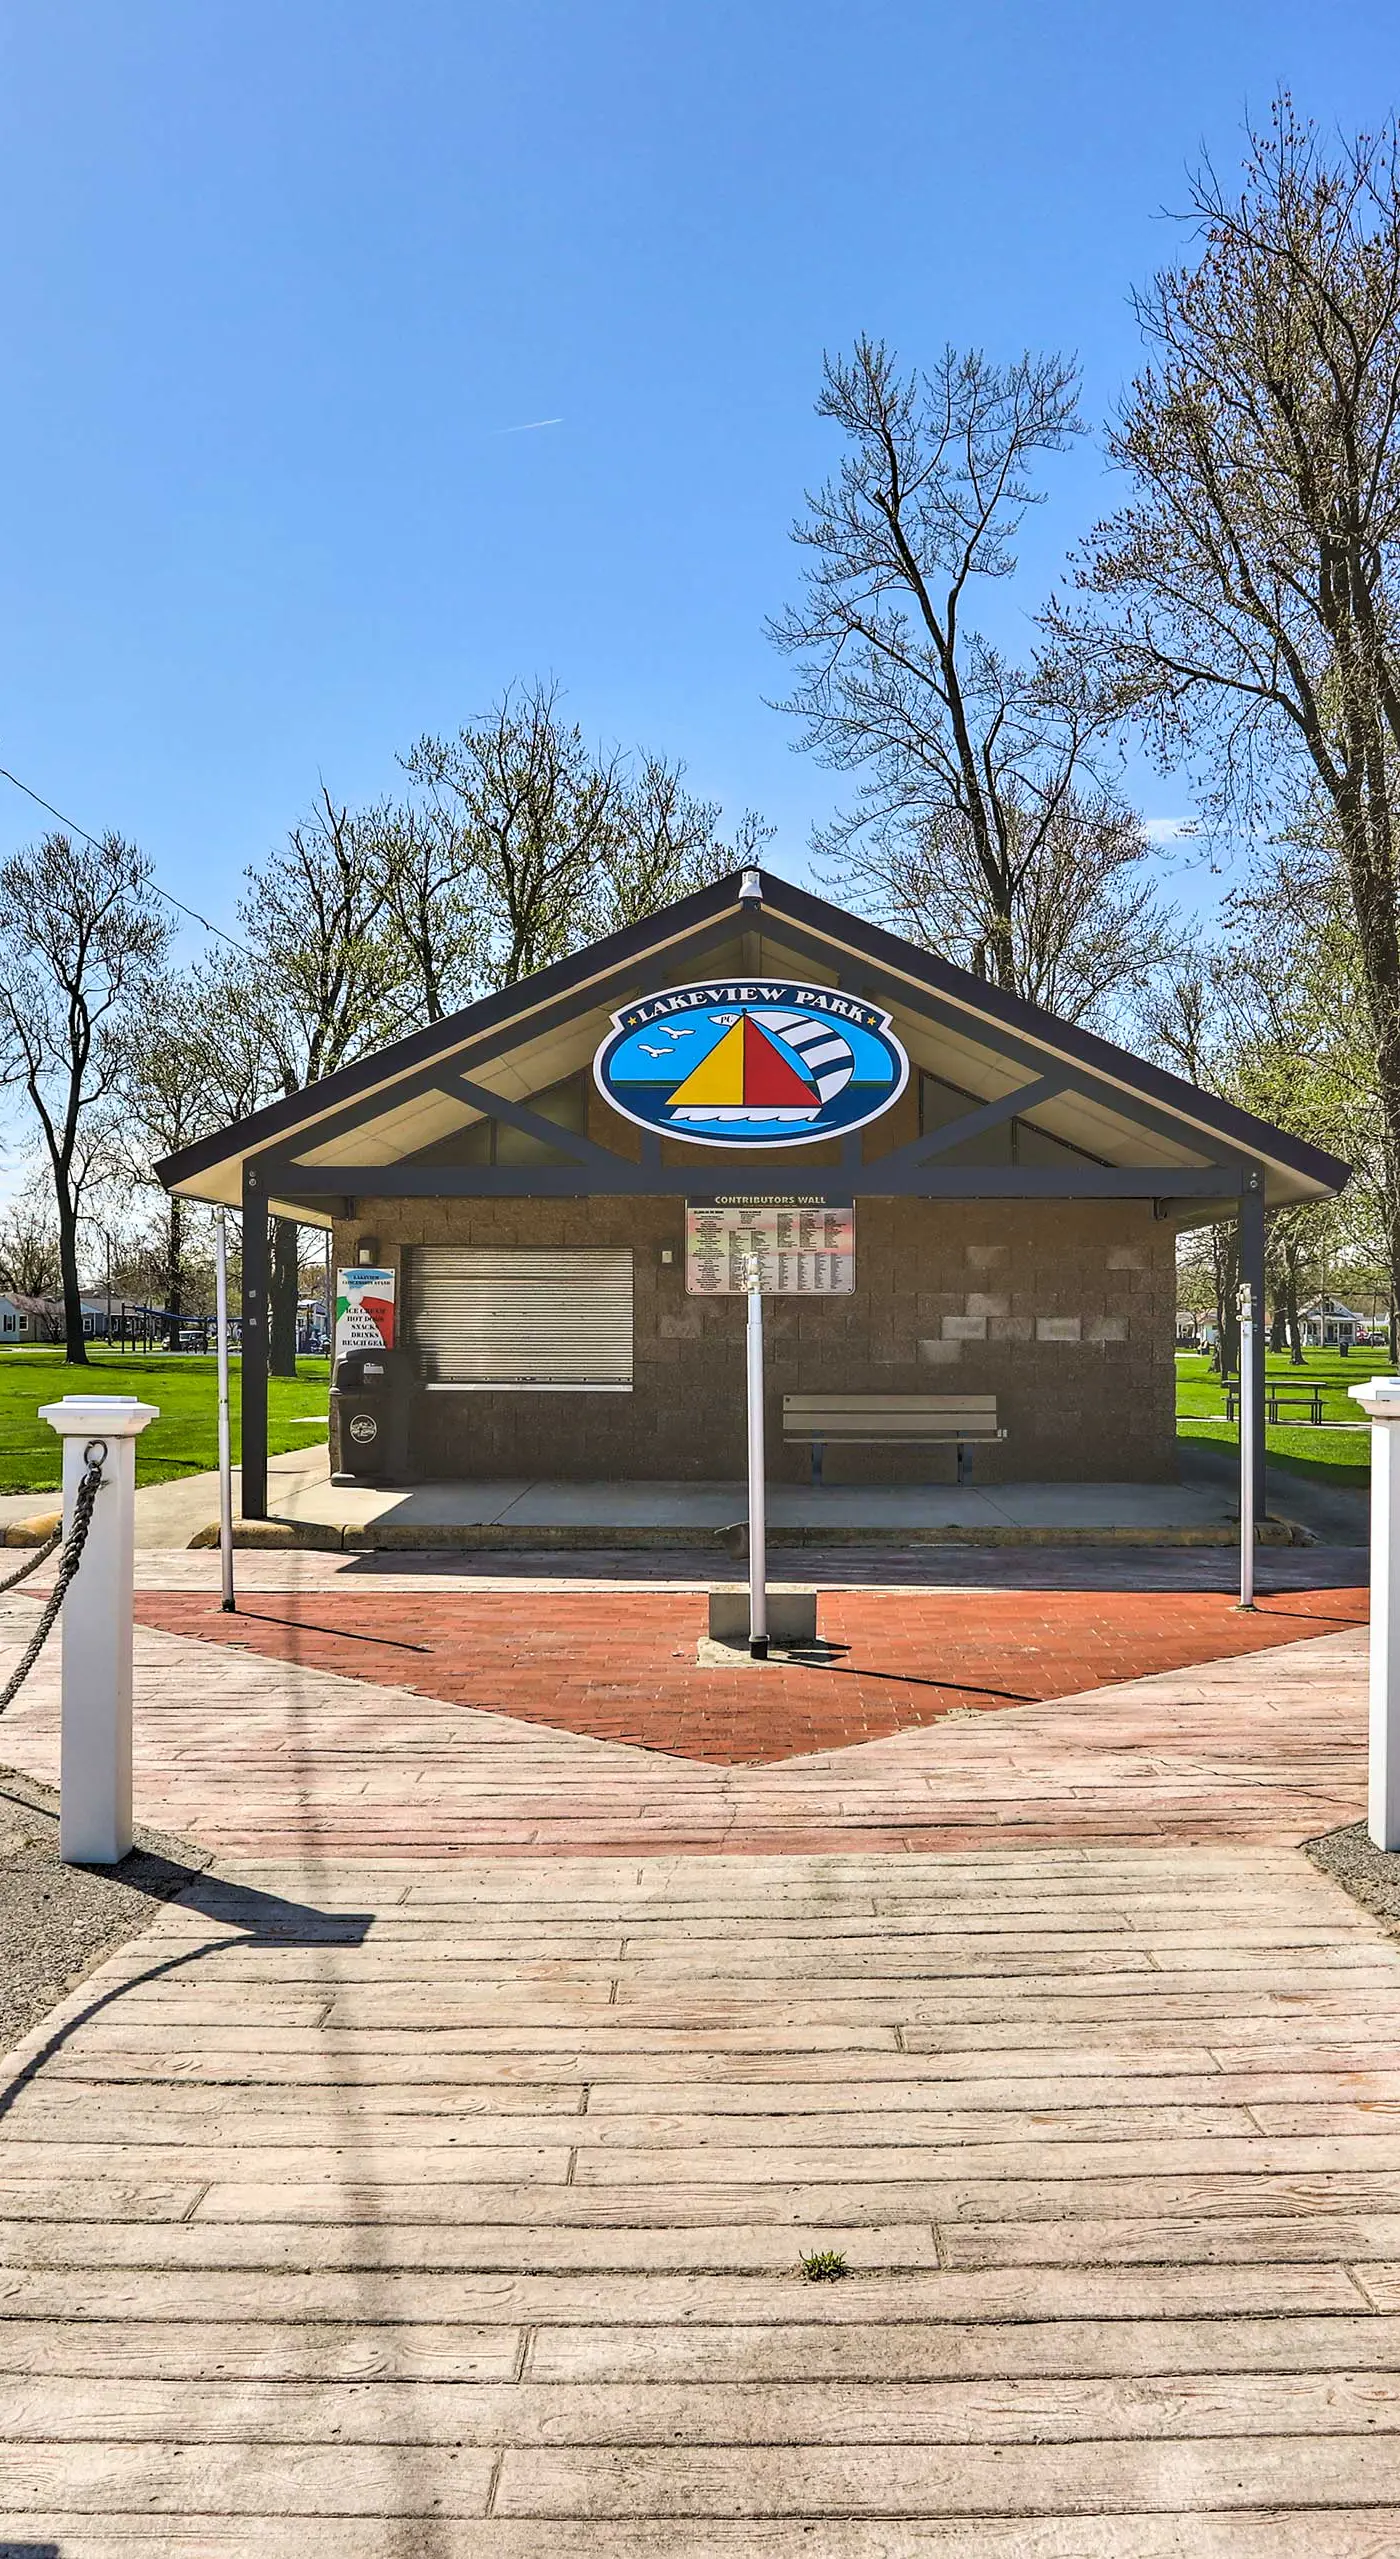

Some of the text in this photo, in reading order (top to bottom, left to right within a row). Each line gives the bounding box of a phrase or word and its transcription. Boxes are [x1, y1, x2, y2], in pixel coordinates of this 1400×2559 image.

[636, 987, 867, 1024] LAKEVIEW PARK
[714, 1196, 827, 1204] CONTRIBUTORS WALL
